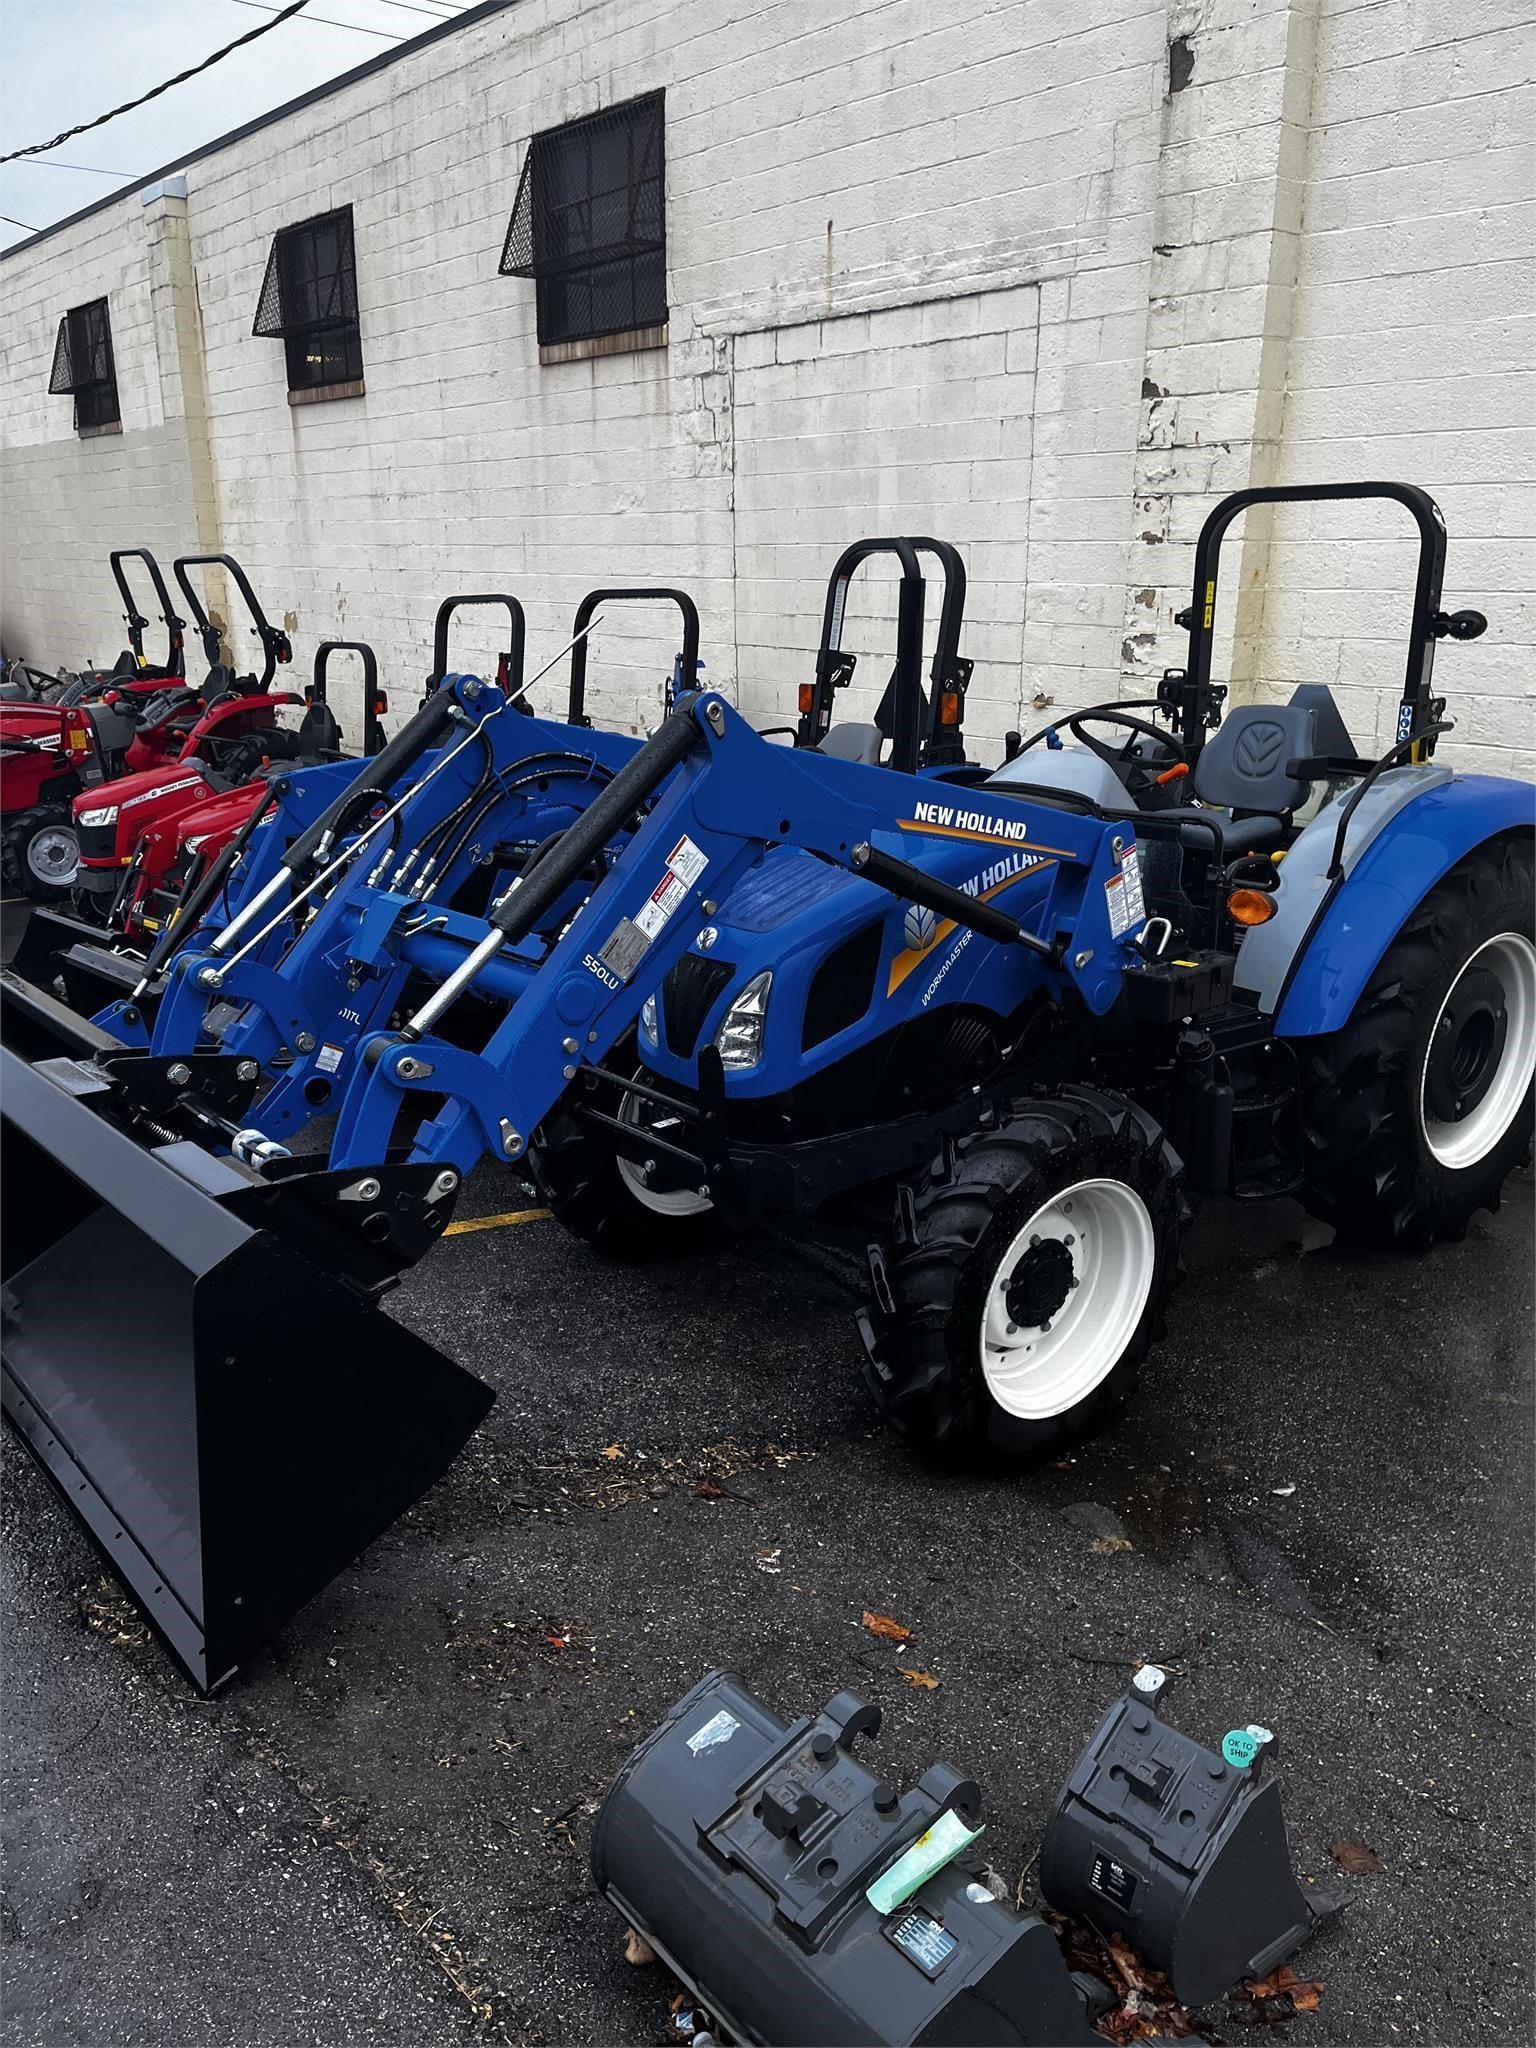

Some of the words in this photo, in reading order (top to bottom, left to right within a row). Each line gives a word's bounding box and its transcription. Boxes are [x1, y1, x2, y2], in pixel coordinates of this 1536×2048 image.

[37, 737, 60, 746] MASSEY
[914, 801, 954, 826] NEW
[955, 810, 1026, 840] HOLLAND
[582, 953, 619, 990] 550LU
[922, 929, 973, 1006] WORKMASTER
[1227, 1738, 1240, 1748] OK
[1243, 1741, 1253, 1751] TO
[1230, 1747, 1249, 1759] SHIP
